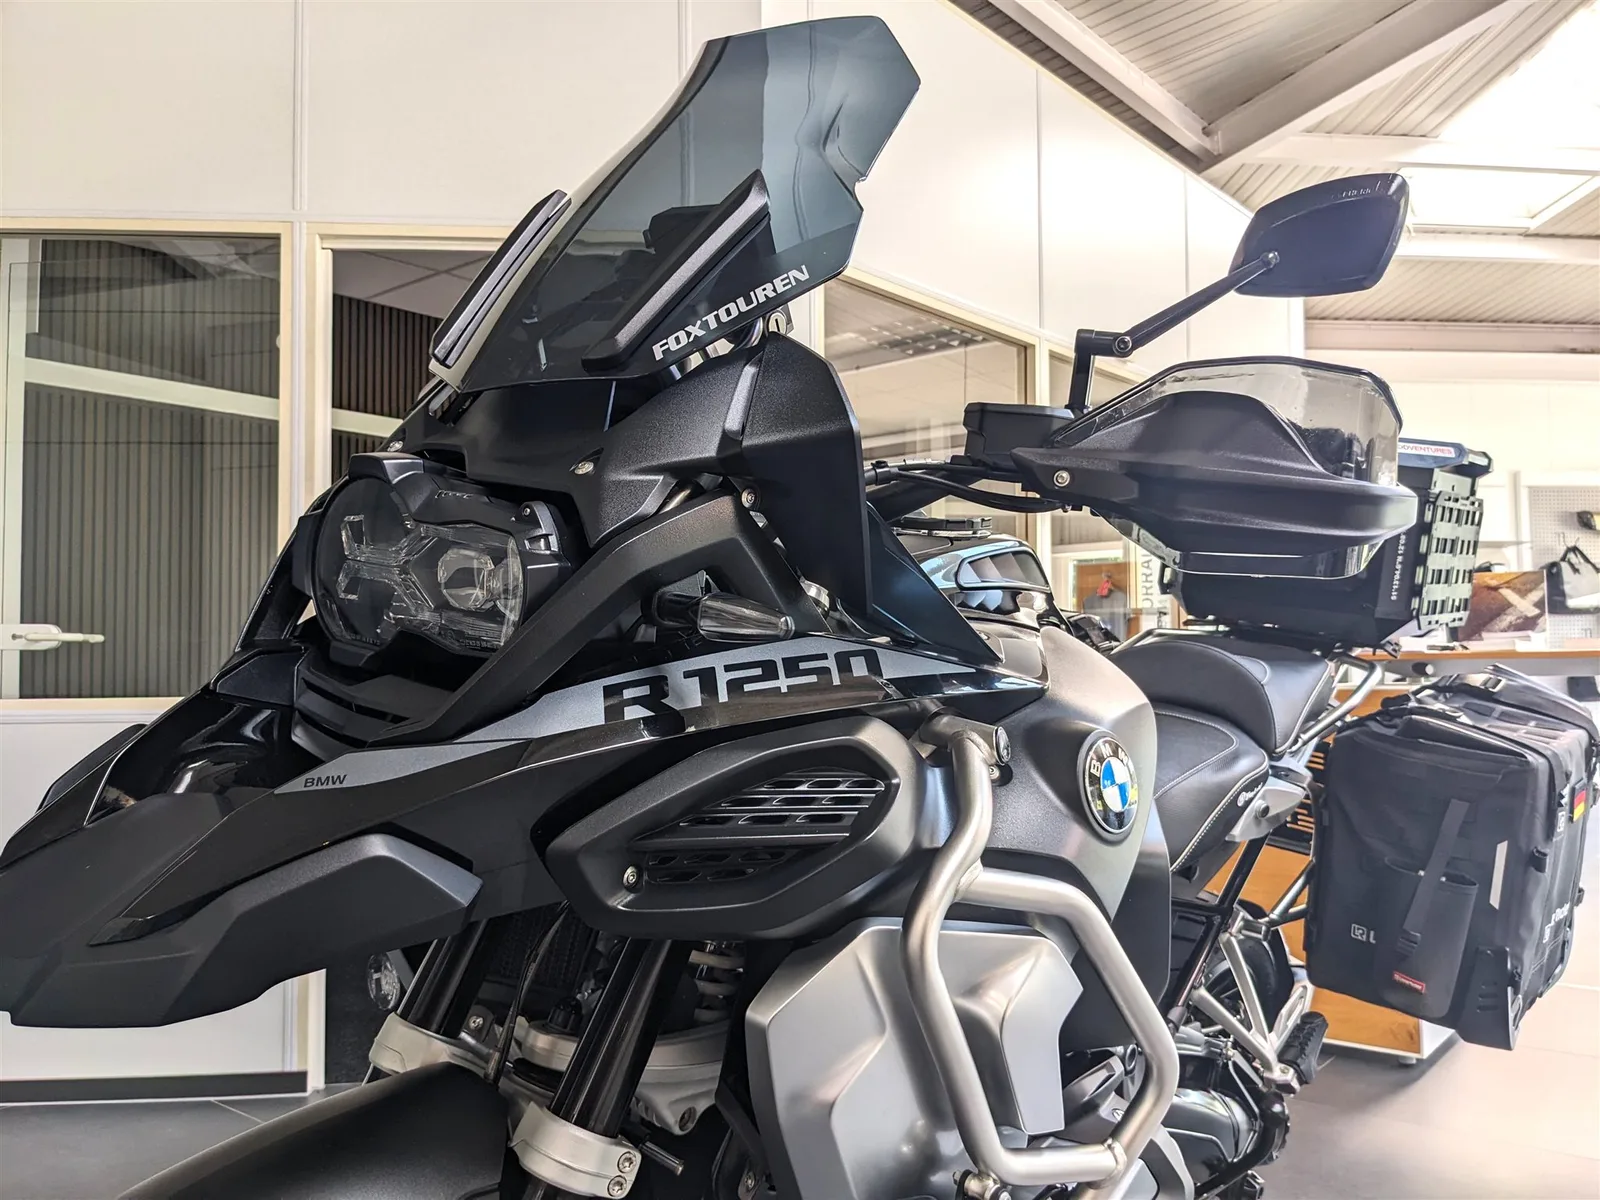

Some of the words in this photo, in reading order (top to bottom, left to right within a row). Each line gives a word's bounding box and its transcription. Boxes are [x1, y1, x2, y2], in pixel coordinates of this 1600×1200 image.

[652, 264, 810, 361] FOXTOUREN
[602, 674, 686, 735] R
[683, 648, 886, 708] 1250
[303, 774, 348, 788] BMW
[1089, 742, 1128, 777] BMW
